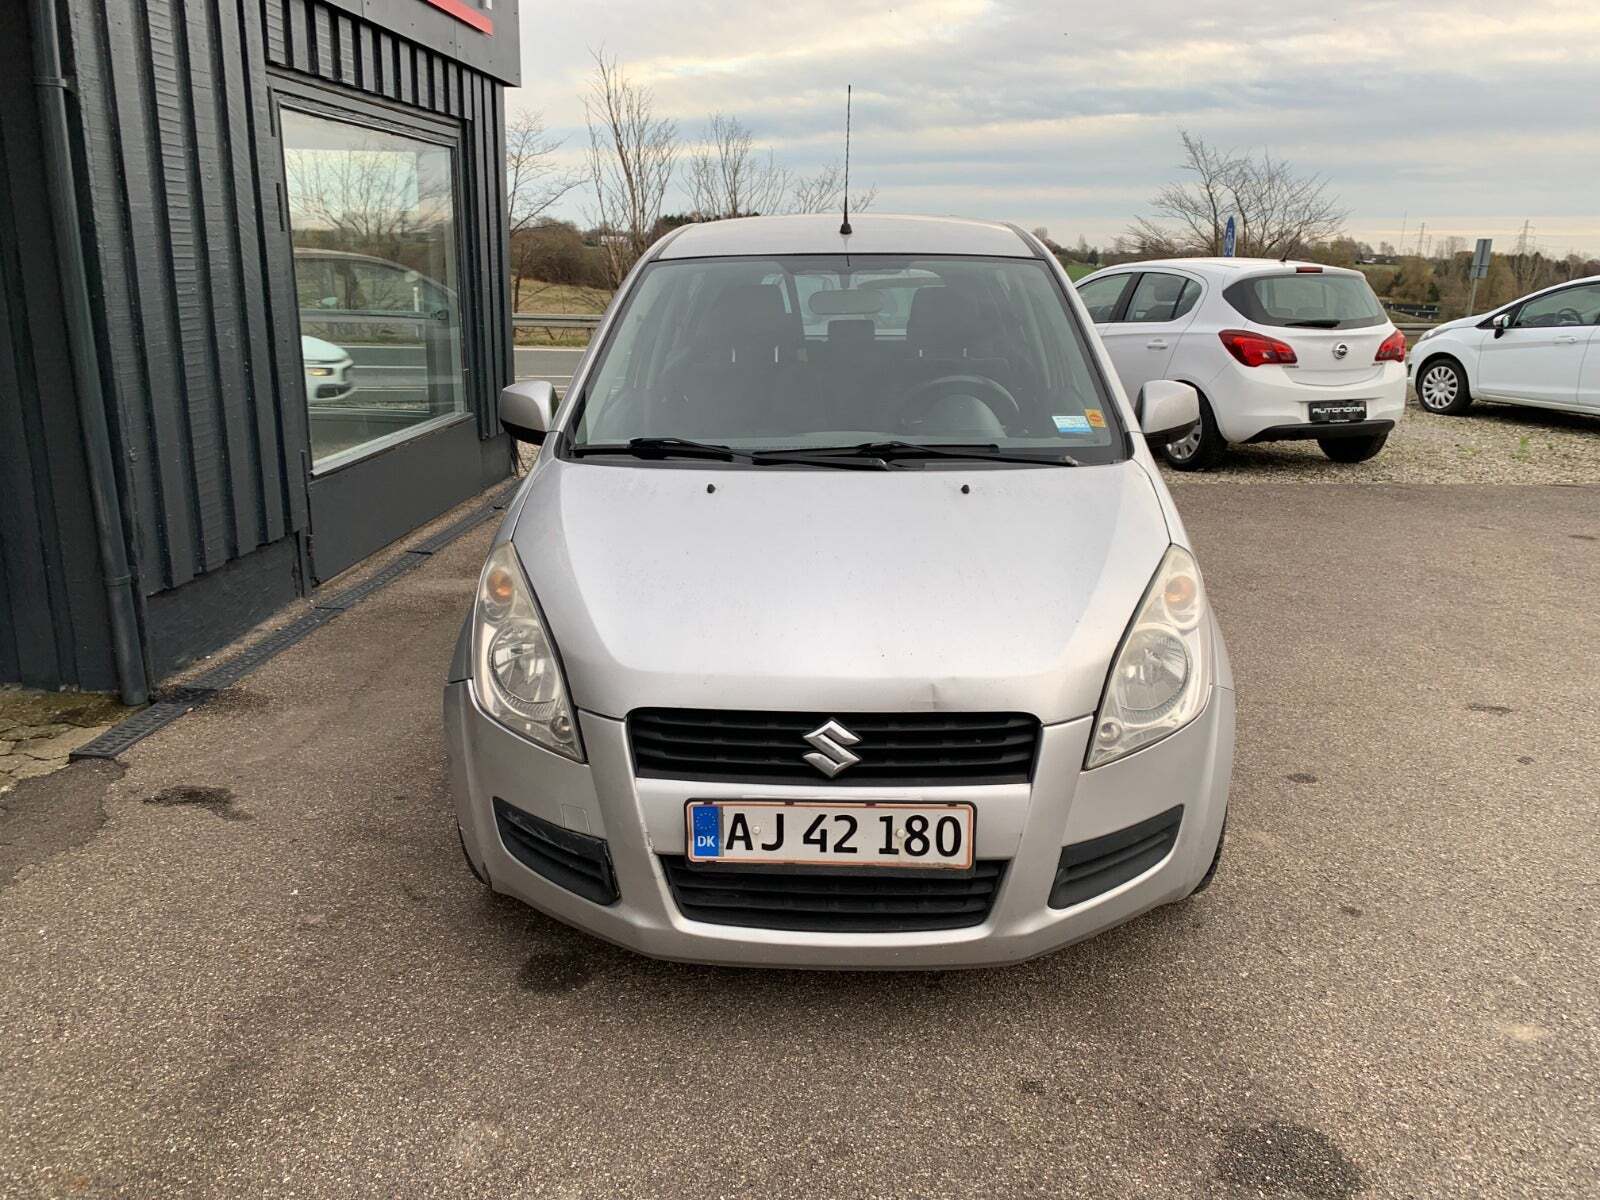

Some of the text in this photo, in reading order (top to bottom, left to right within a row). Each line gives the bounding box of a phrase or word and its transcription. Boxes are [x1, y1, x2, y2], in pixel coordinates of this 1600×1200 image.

[697, 835, 715, 848] DK
[725, 813, 962, 857] AJ 42 180
